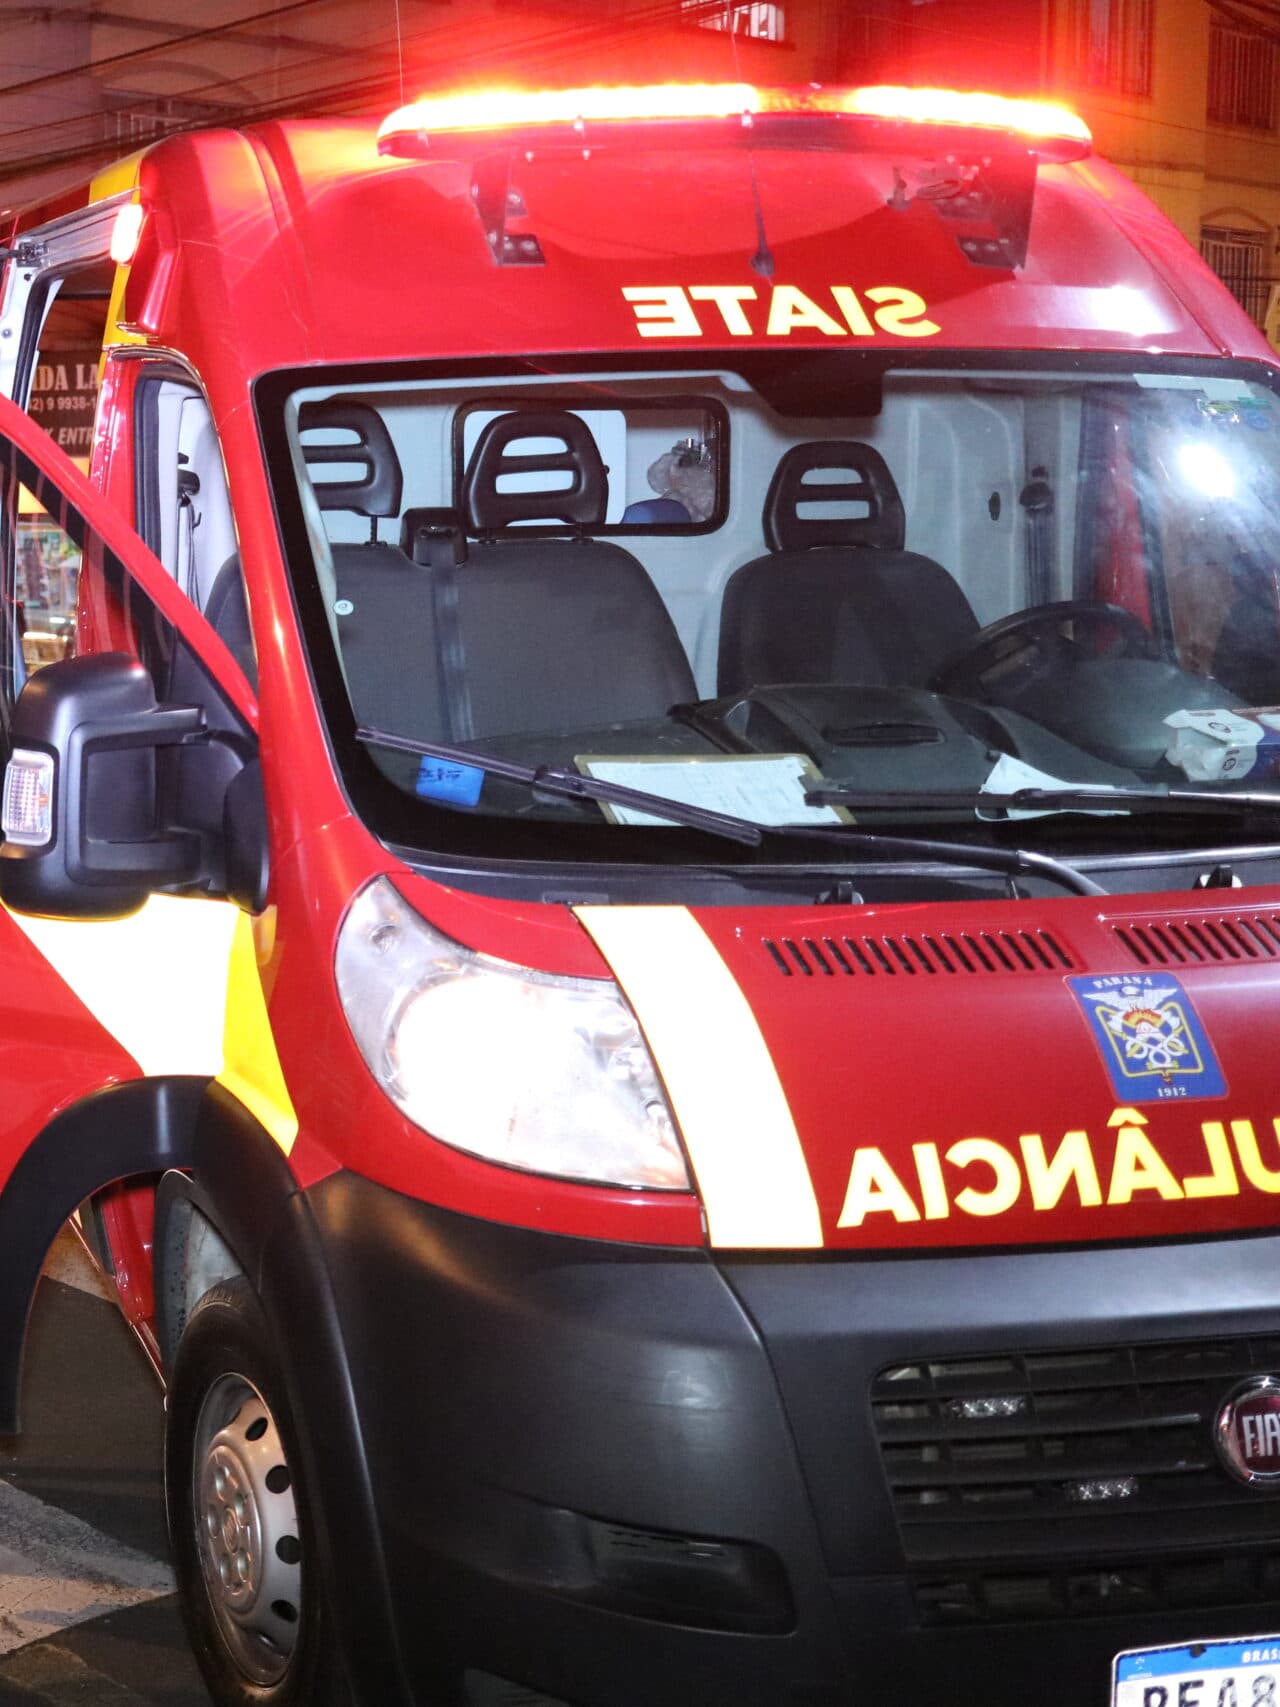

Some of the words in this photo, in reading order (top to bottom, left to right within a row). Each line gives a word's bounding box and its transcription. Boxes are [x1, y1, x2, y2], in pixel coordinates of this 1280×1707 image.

[1157, 1087, 1187, 1098] 1912
[1241, 1413, 1280, 1459] FIA
[1241, 1648, 1280, 1664] BRAS
